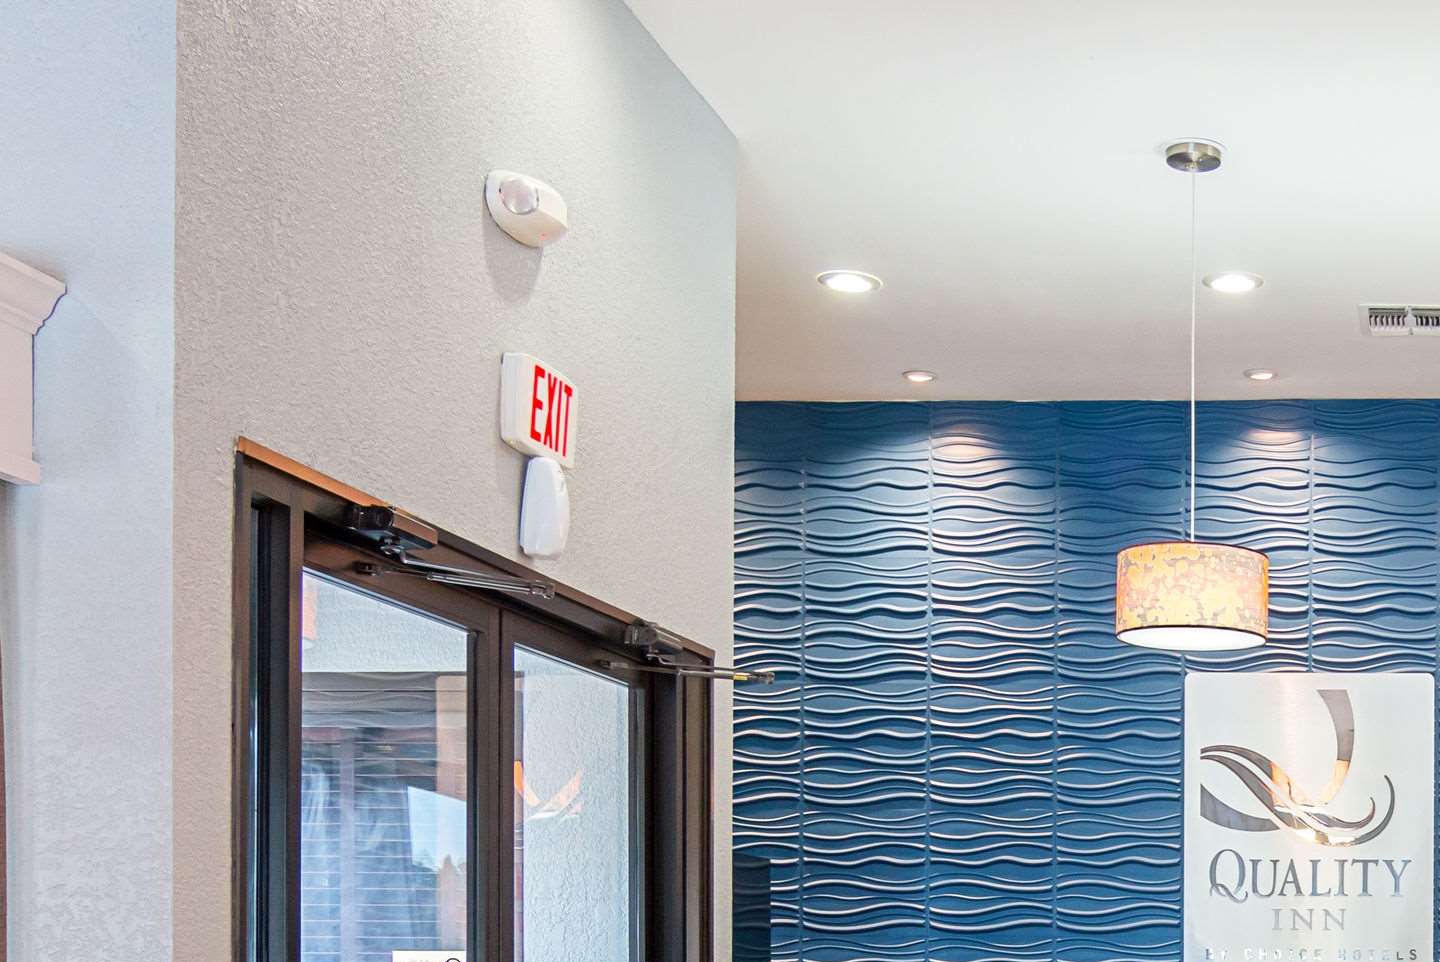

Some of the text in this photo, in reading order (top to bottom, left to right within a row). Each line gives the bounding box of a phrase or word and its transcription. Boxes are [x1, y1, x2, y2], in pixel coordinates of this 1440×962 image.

[530, 365, 573, 457] EXIT
[1209, 849, 1412, 903] QUALITY
[1271, 908, 1347, 931] INN
